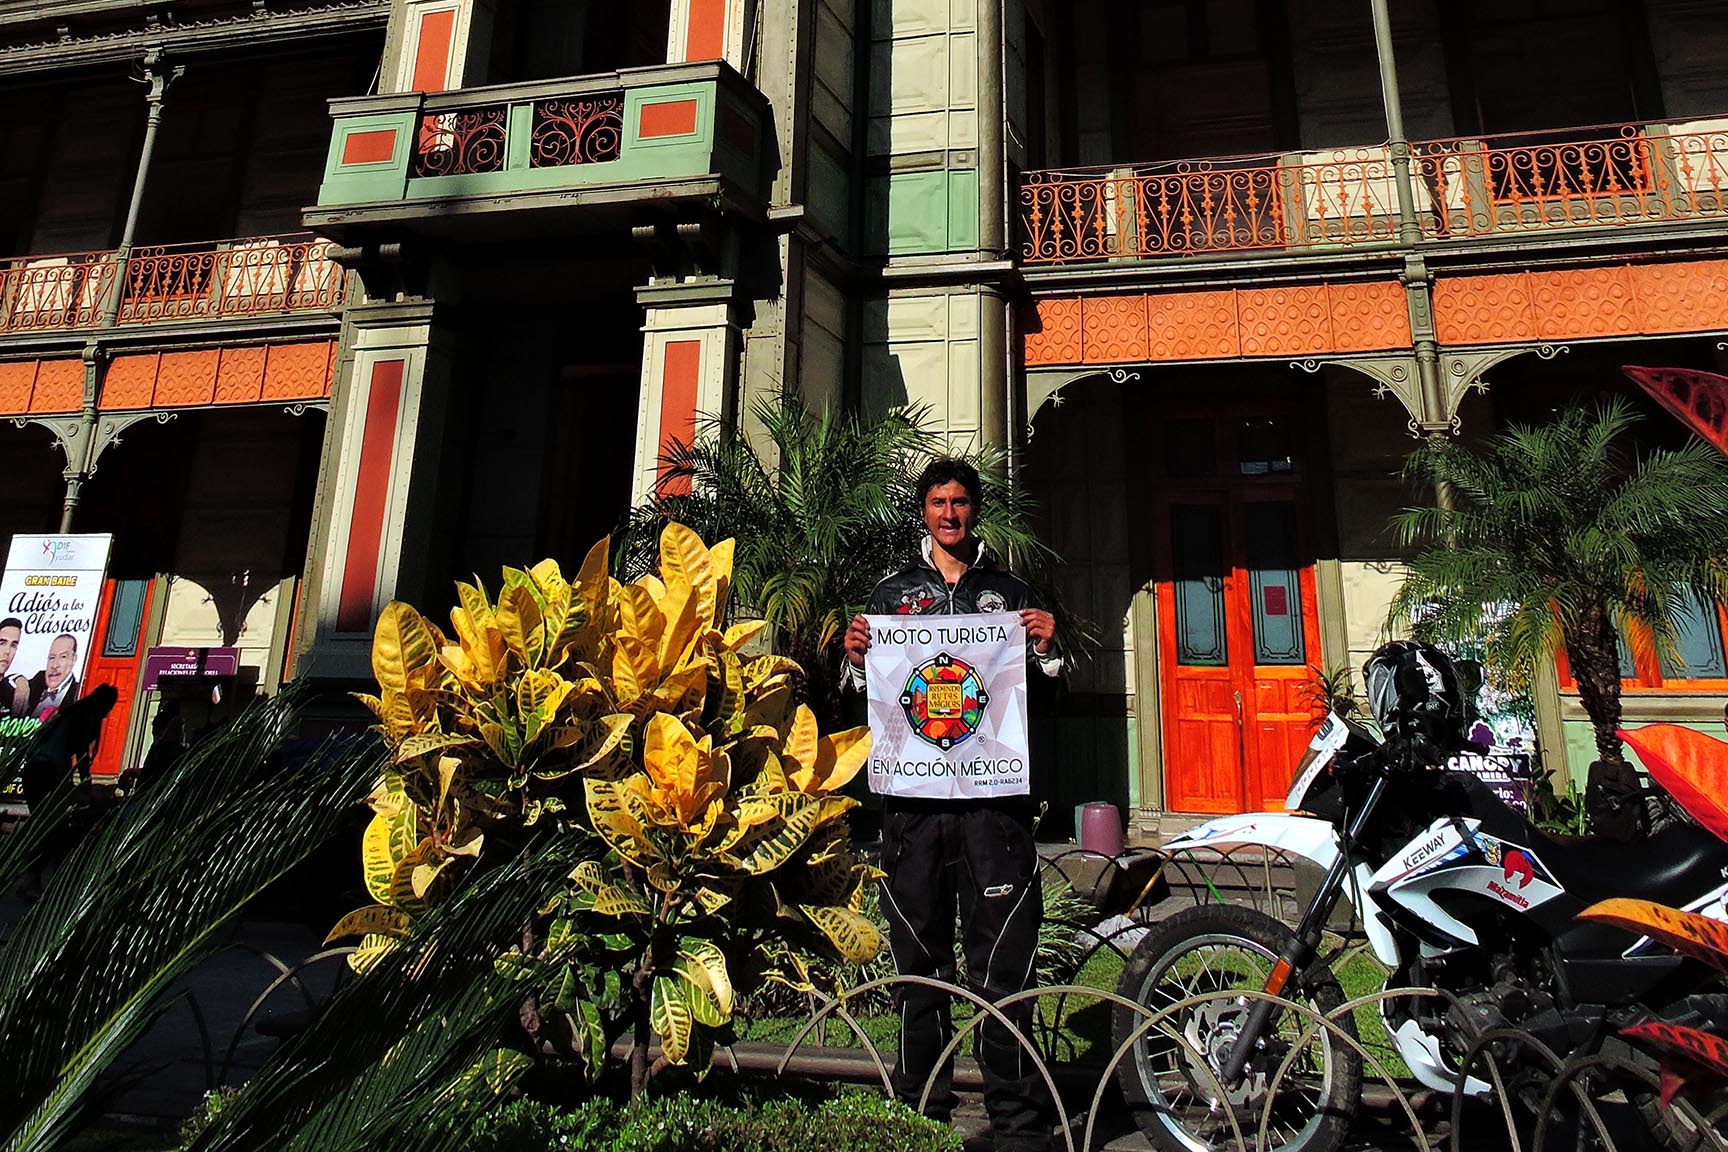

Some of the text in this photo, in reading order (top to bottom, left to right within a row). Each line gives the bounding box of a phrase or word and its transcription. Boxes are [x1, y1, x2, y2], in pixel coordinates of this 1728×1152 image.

[57, 541, 71, 550] DIF
[25, 575, 78, 587] GRAN BAILE
[8, 591, 84, 614] Adiós a los
[24, 612, 90, 635] Clásicos
[877, 626, 1008, 645] MOTO TURISTA
[938, 656, 949, 665] N
[978, 695, 987, 703] E
[941, 739, 950, 747] S
[873, 756, 1023, 777] EN ACCIÓN MÉXICO
[1447, 755, 1522, 773] CANOPY
[1402, 832, 1446, 870] KEEWAY
[1486, 880, 1529, 909] Mazamitla
